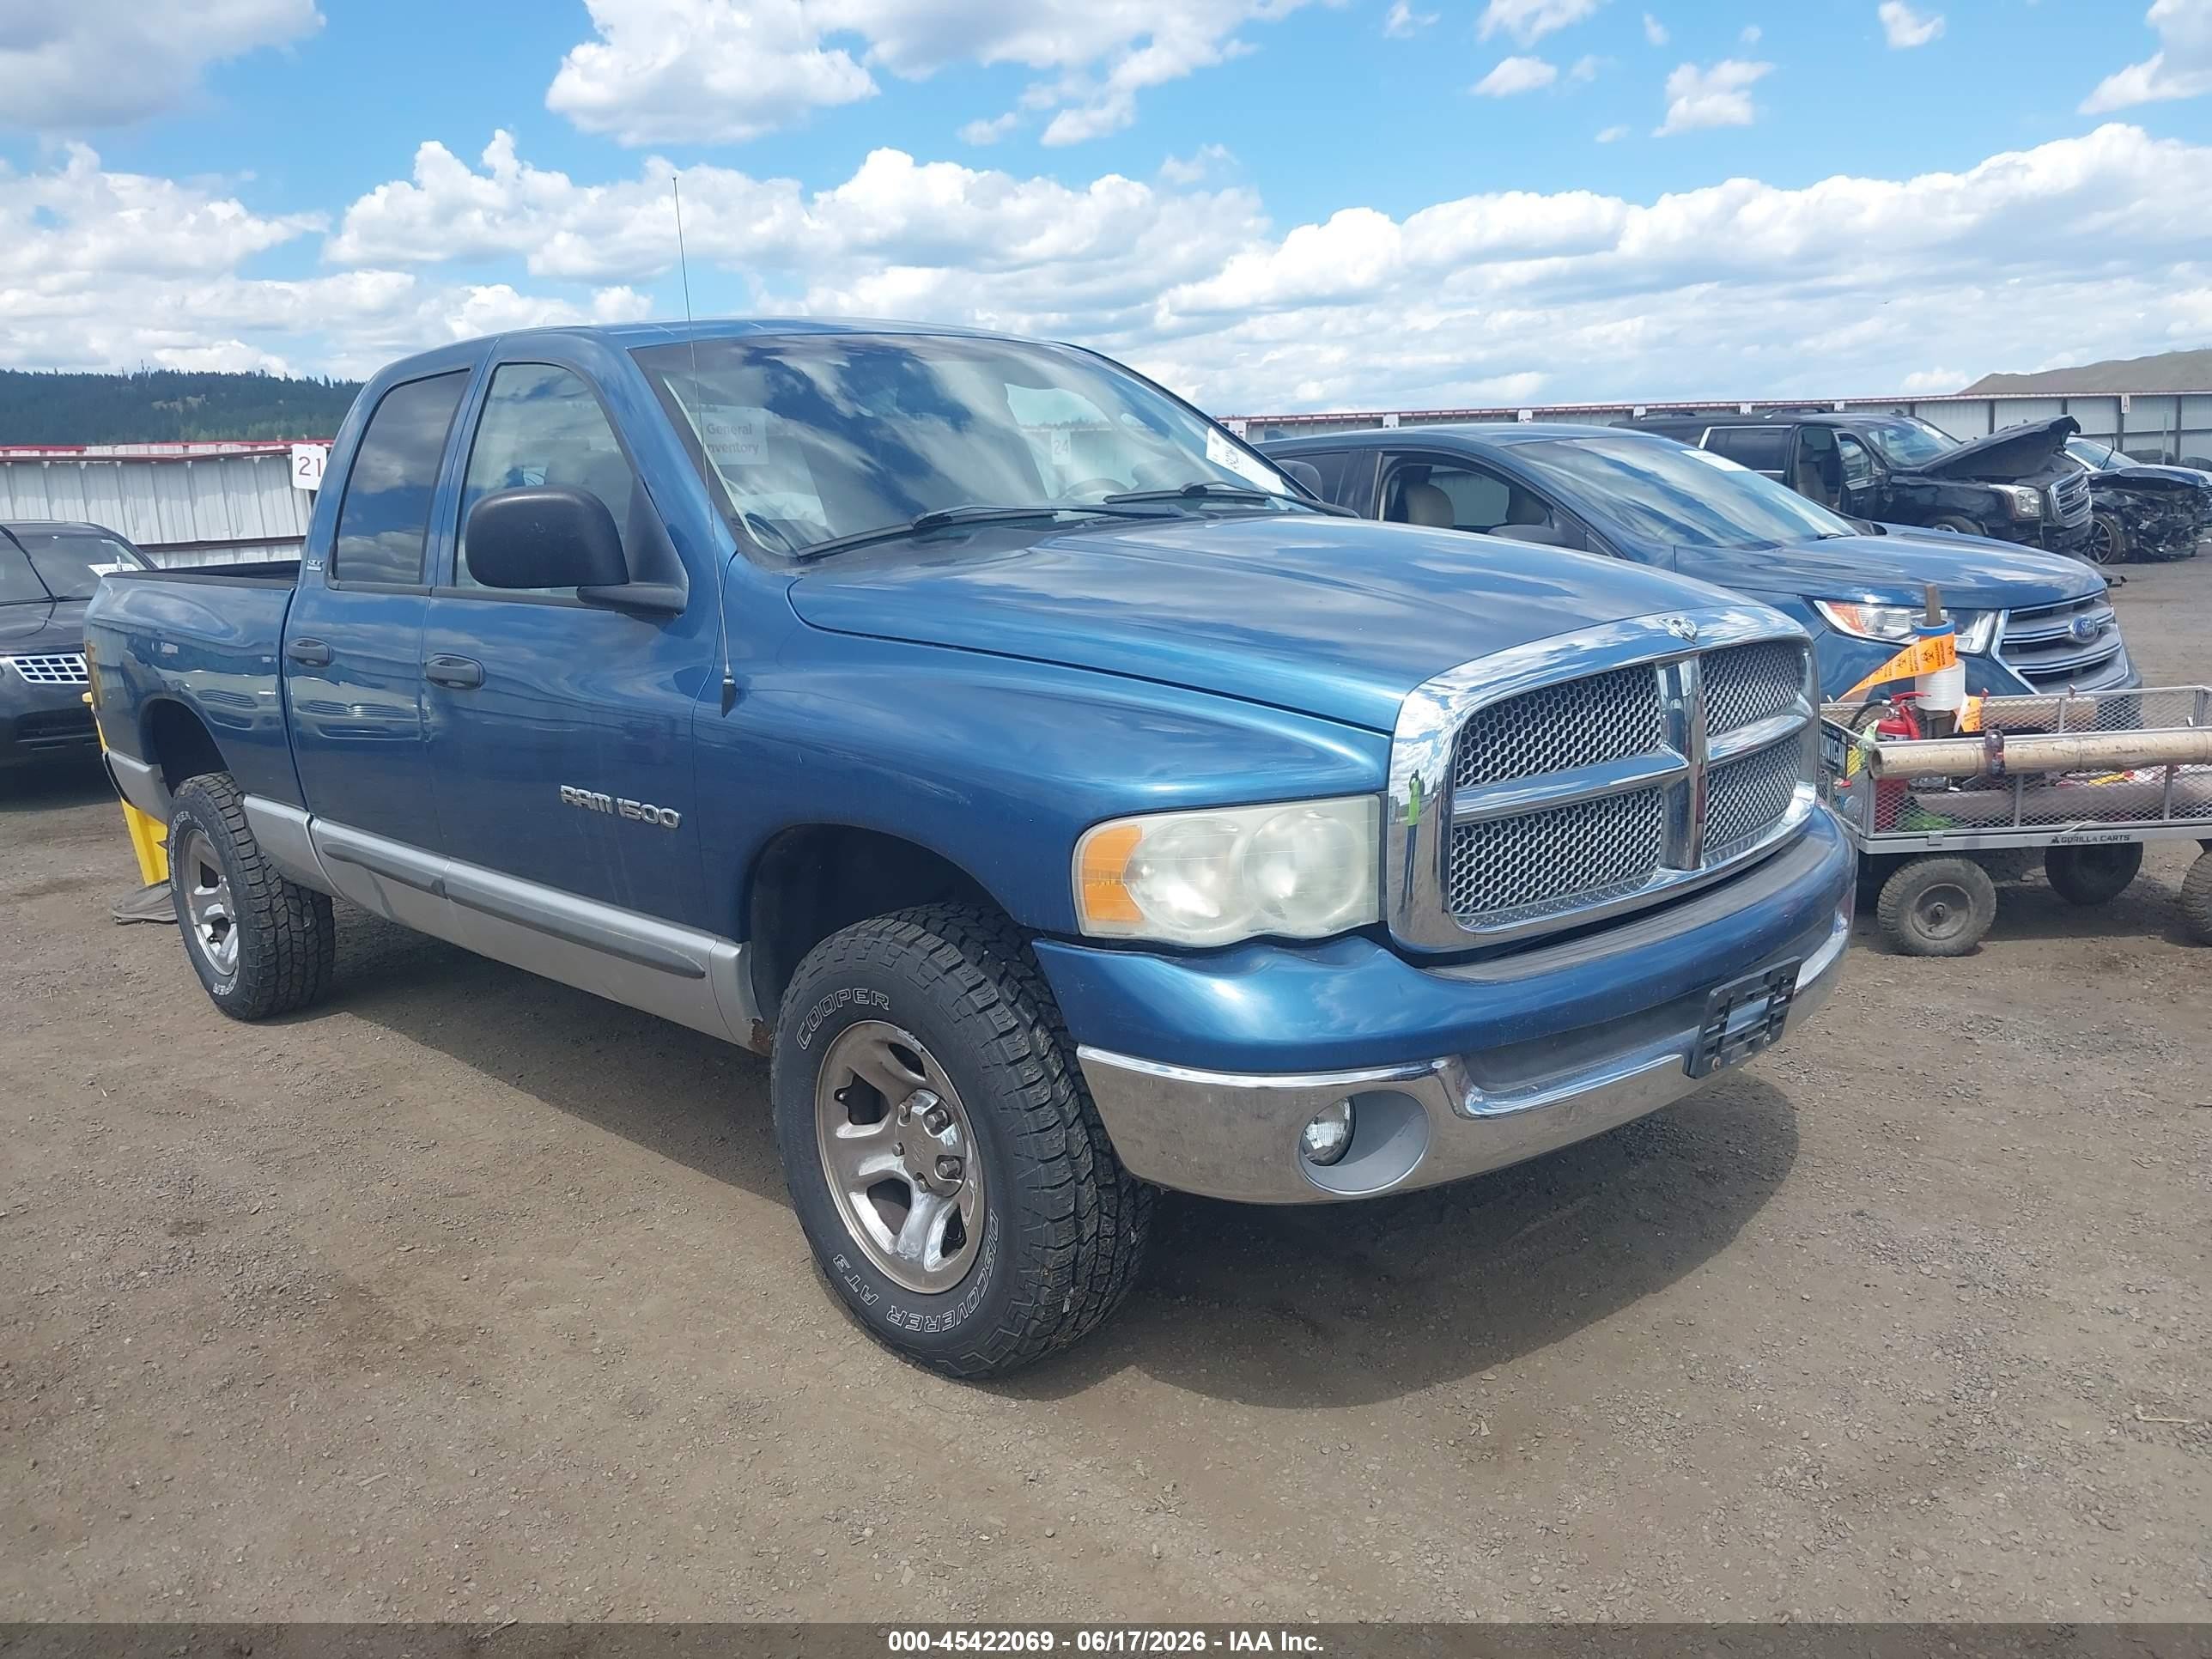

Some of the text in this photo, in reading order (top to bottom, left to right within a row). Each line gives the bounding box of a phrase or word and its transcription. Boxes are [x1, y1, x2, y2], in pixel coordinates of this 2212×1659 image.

[706, 422, 752, 435] General
[1053, 439, 1069, 454] 24
[297, 456, 322, 477] 21
[560, 784, 681, 829] RAM 1500
[2061, 834, 2130, 843] GORILLA CARTS
[797, 988, 890, 1050] COOPER
[832, 1207, 1000, 1334] DISCOVERER AT3
